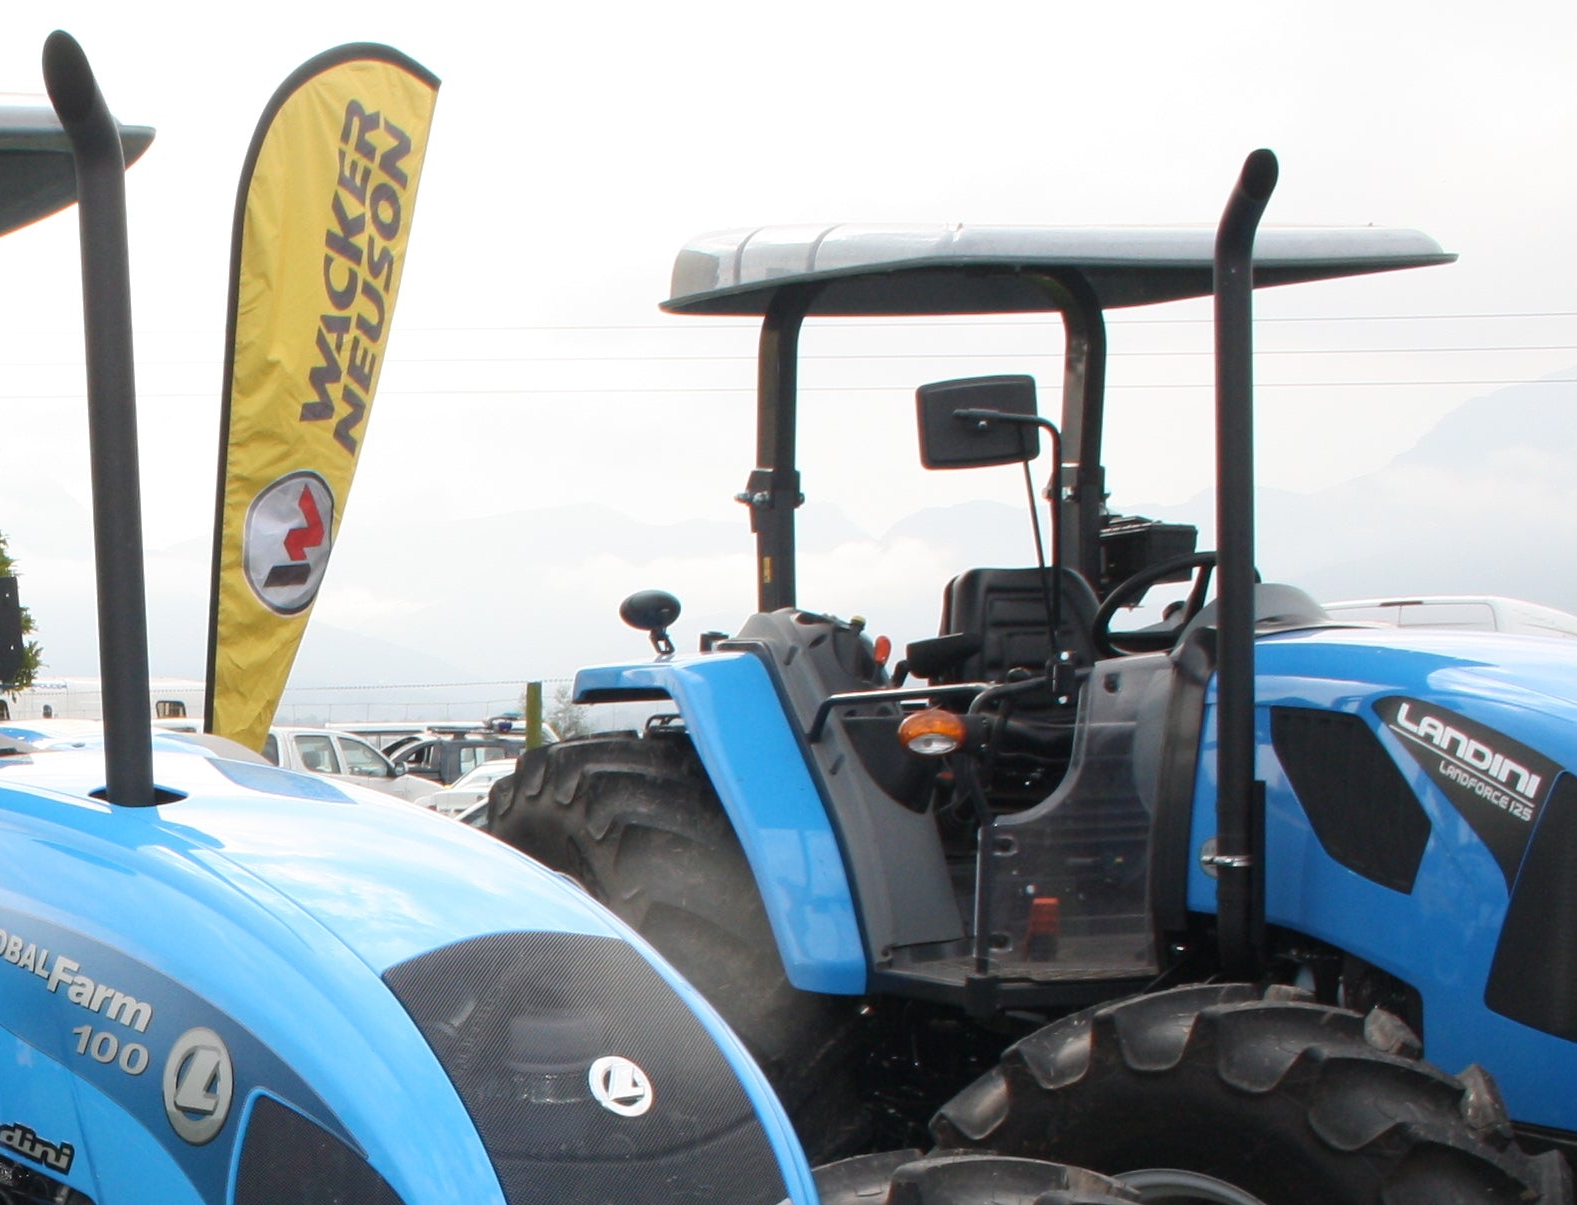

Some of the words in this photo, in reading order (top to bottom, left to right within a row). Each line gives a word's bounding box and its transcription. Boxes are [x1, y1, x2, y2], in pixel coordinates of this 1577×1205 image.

[299, 98, 380, 423] WACKER
[333, 116, 413, 457] NEUSON
[1396, 702, 1543, 799] LANDINI
[1439, 761, 1508, 811] LANDFORCE
[1509, 801, 1534, 821] 125
[72, 1024, 150, 1076] 100
